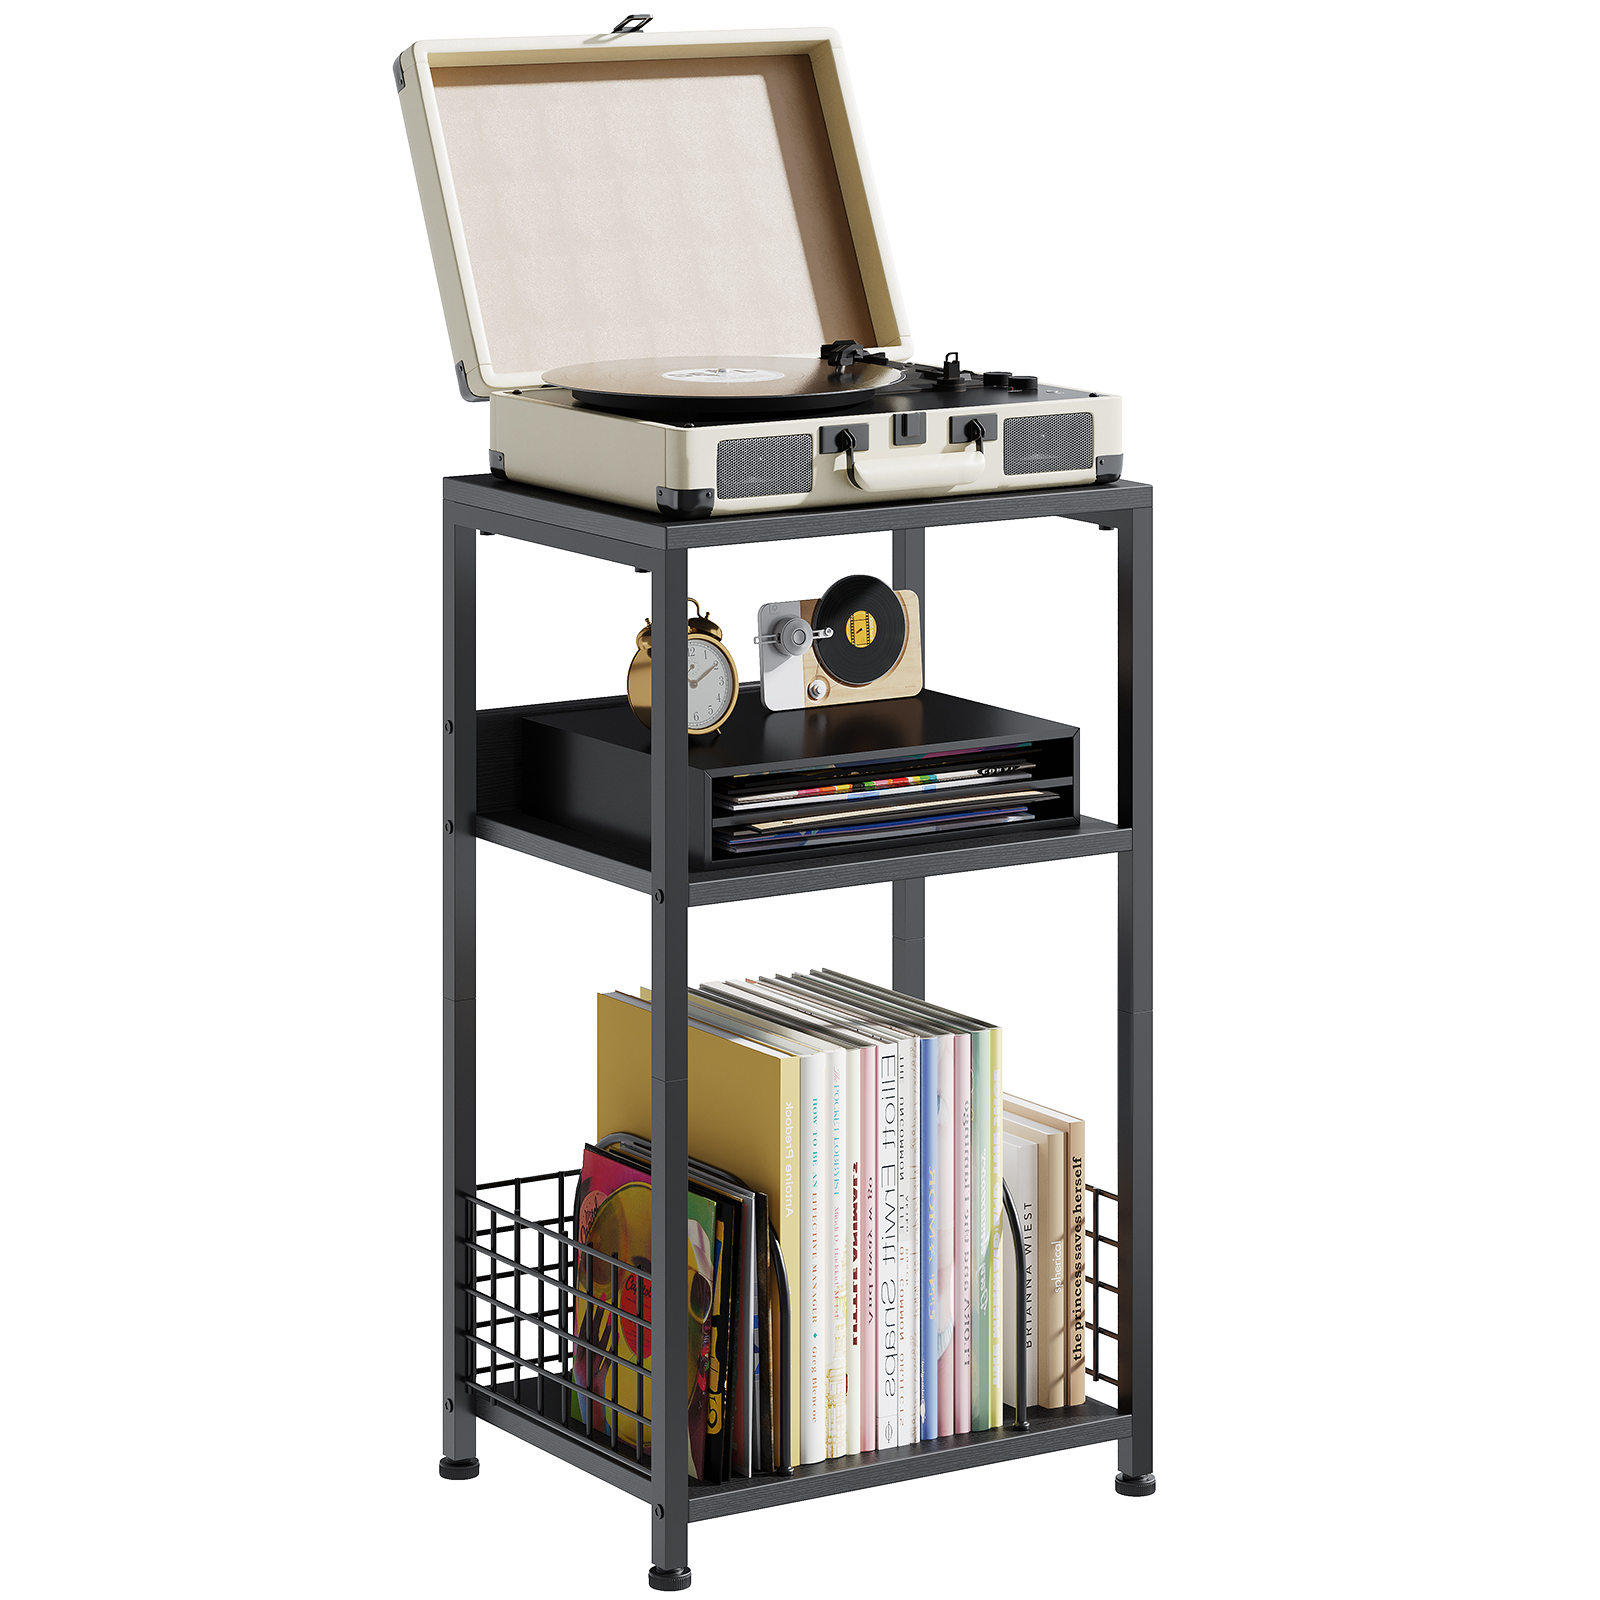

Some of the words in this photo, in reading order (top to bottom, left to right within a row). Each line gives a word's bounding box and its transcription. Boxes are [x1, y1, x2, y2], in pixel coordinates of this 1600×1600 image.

[719, 675, 725, 686] 3
[693, 711, 700, 721] 6
[708, 704, 714, 715] 5
[1072, 1156, 1082, 1213] herself
[1023, 1202, 1033, 1255] WIEST
[1073, 1215, 1082, 1260] saves
[1050, 1240, 1063, 1293] spherical
[625, 1274, 652, 1298] Captol
[1072, 1261, 1084, 1331] princess
[1072, 1333, 1082, 1361] the
